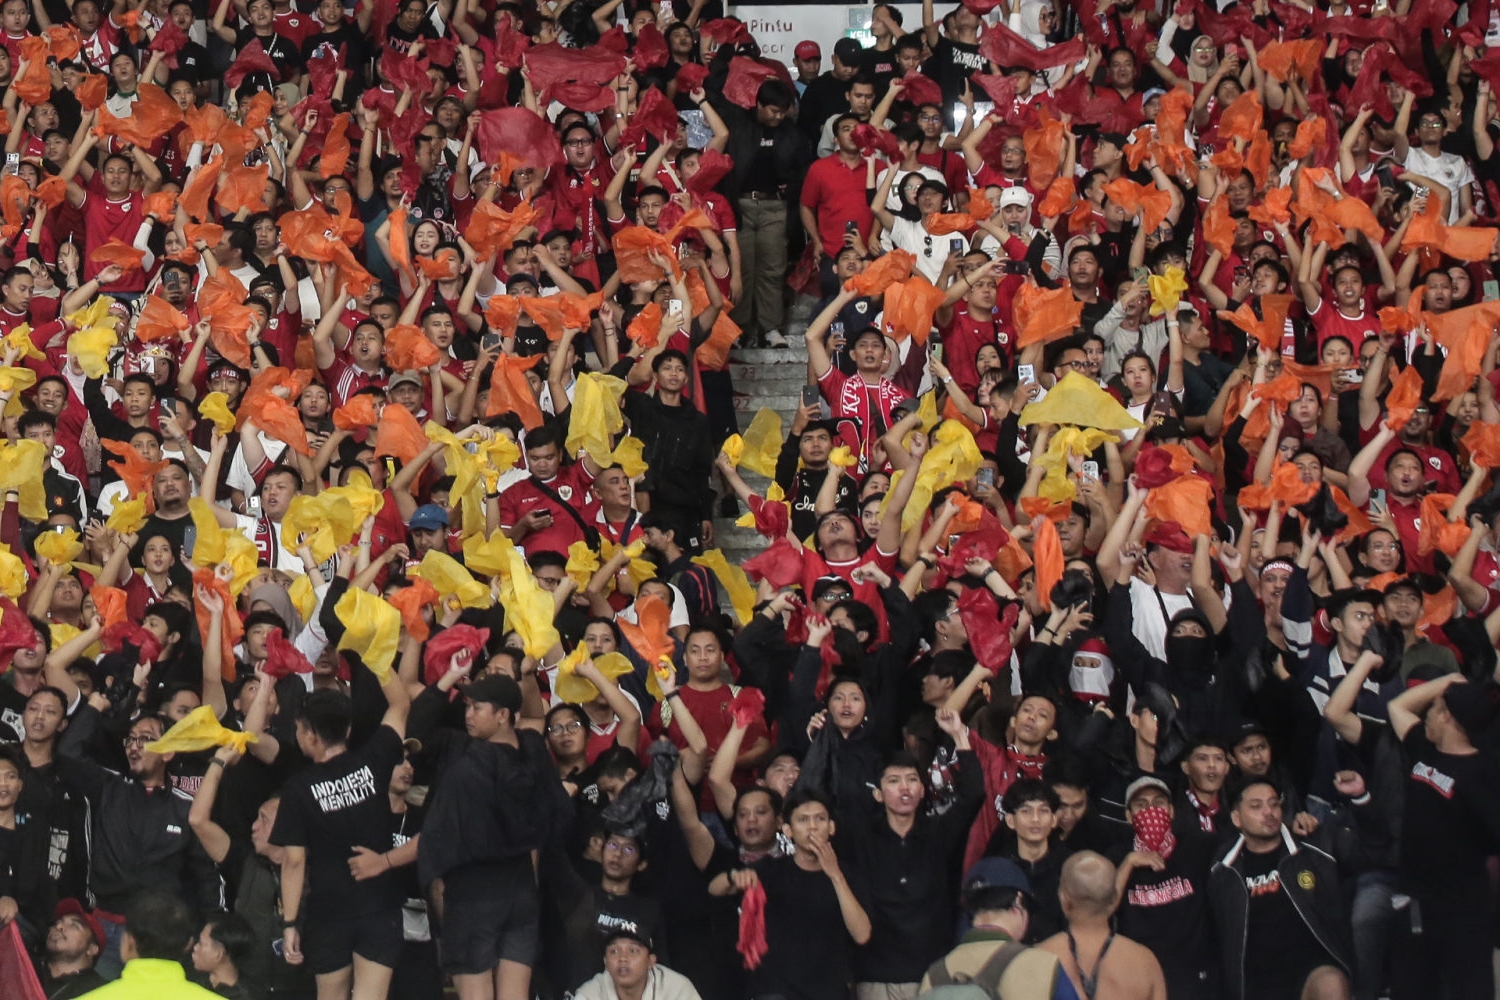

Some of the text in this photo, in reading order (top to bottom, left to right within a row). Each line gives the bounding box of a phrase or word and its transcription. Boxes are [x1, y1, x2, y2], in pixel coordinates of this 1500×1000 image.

[751, 20, 793, 32] Pintu
[761, 44, 784, 54] oor
[311, 765, 374, 799] INDONESIA
[319, 781, 376, 811] MENTALITY
[1129, 878, 1193, 906] INDONESIA
